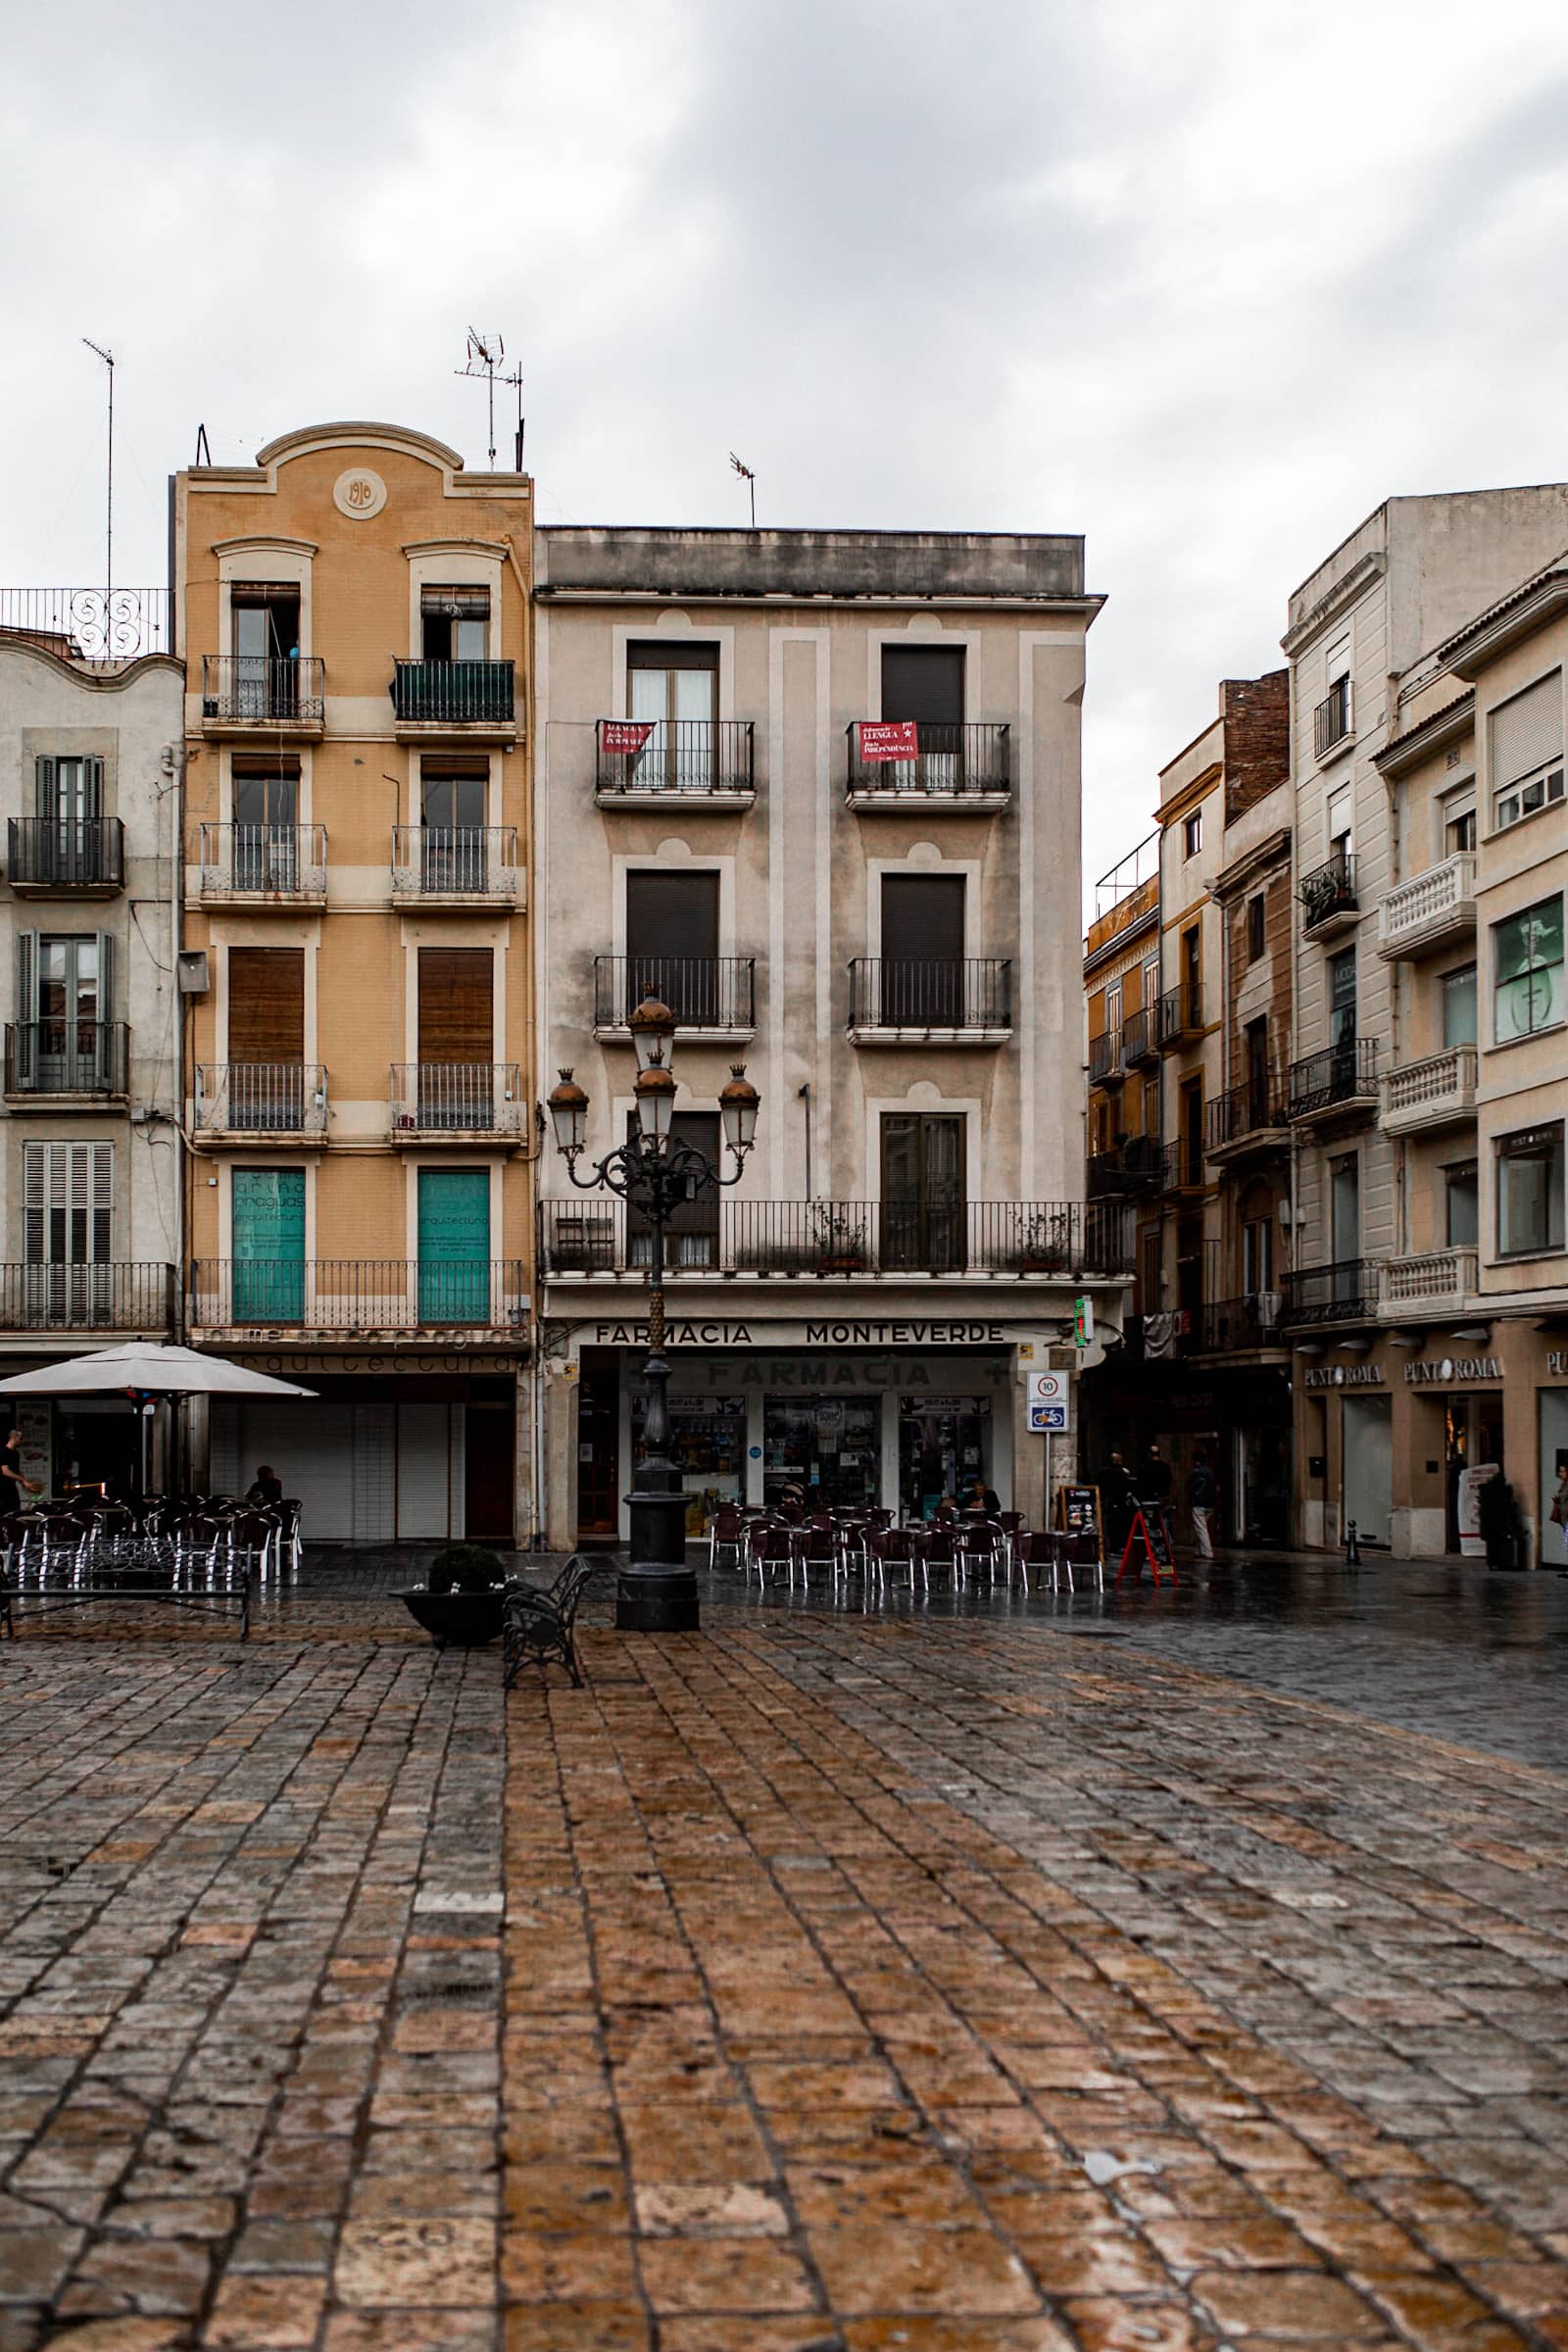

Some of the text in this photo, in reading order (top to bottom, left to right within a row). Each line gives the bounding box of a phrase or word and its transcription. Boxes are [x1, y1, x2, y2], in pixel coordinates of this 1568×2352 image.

[863, 731, 898, 740] LLENGUA
[807, 1324, 1004, 1343] MONTEVERDE
[708, 1359, 931, 1386] FARMACIA
[1043, 1382, 1054, 1392] 10
